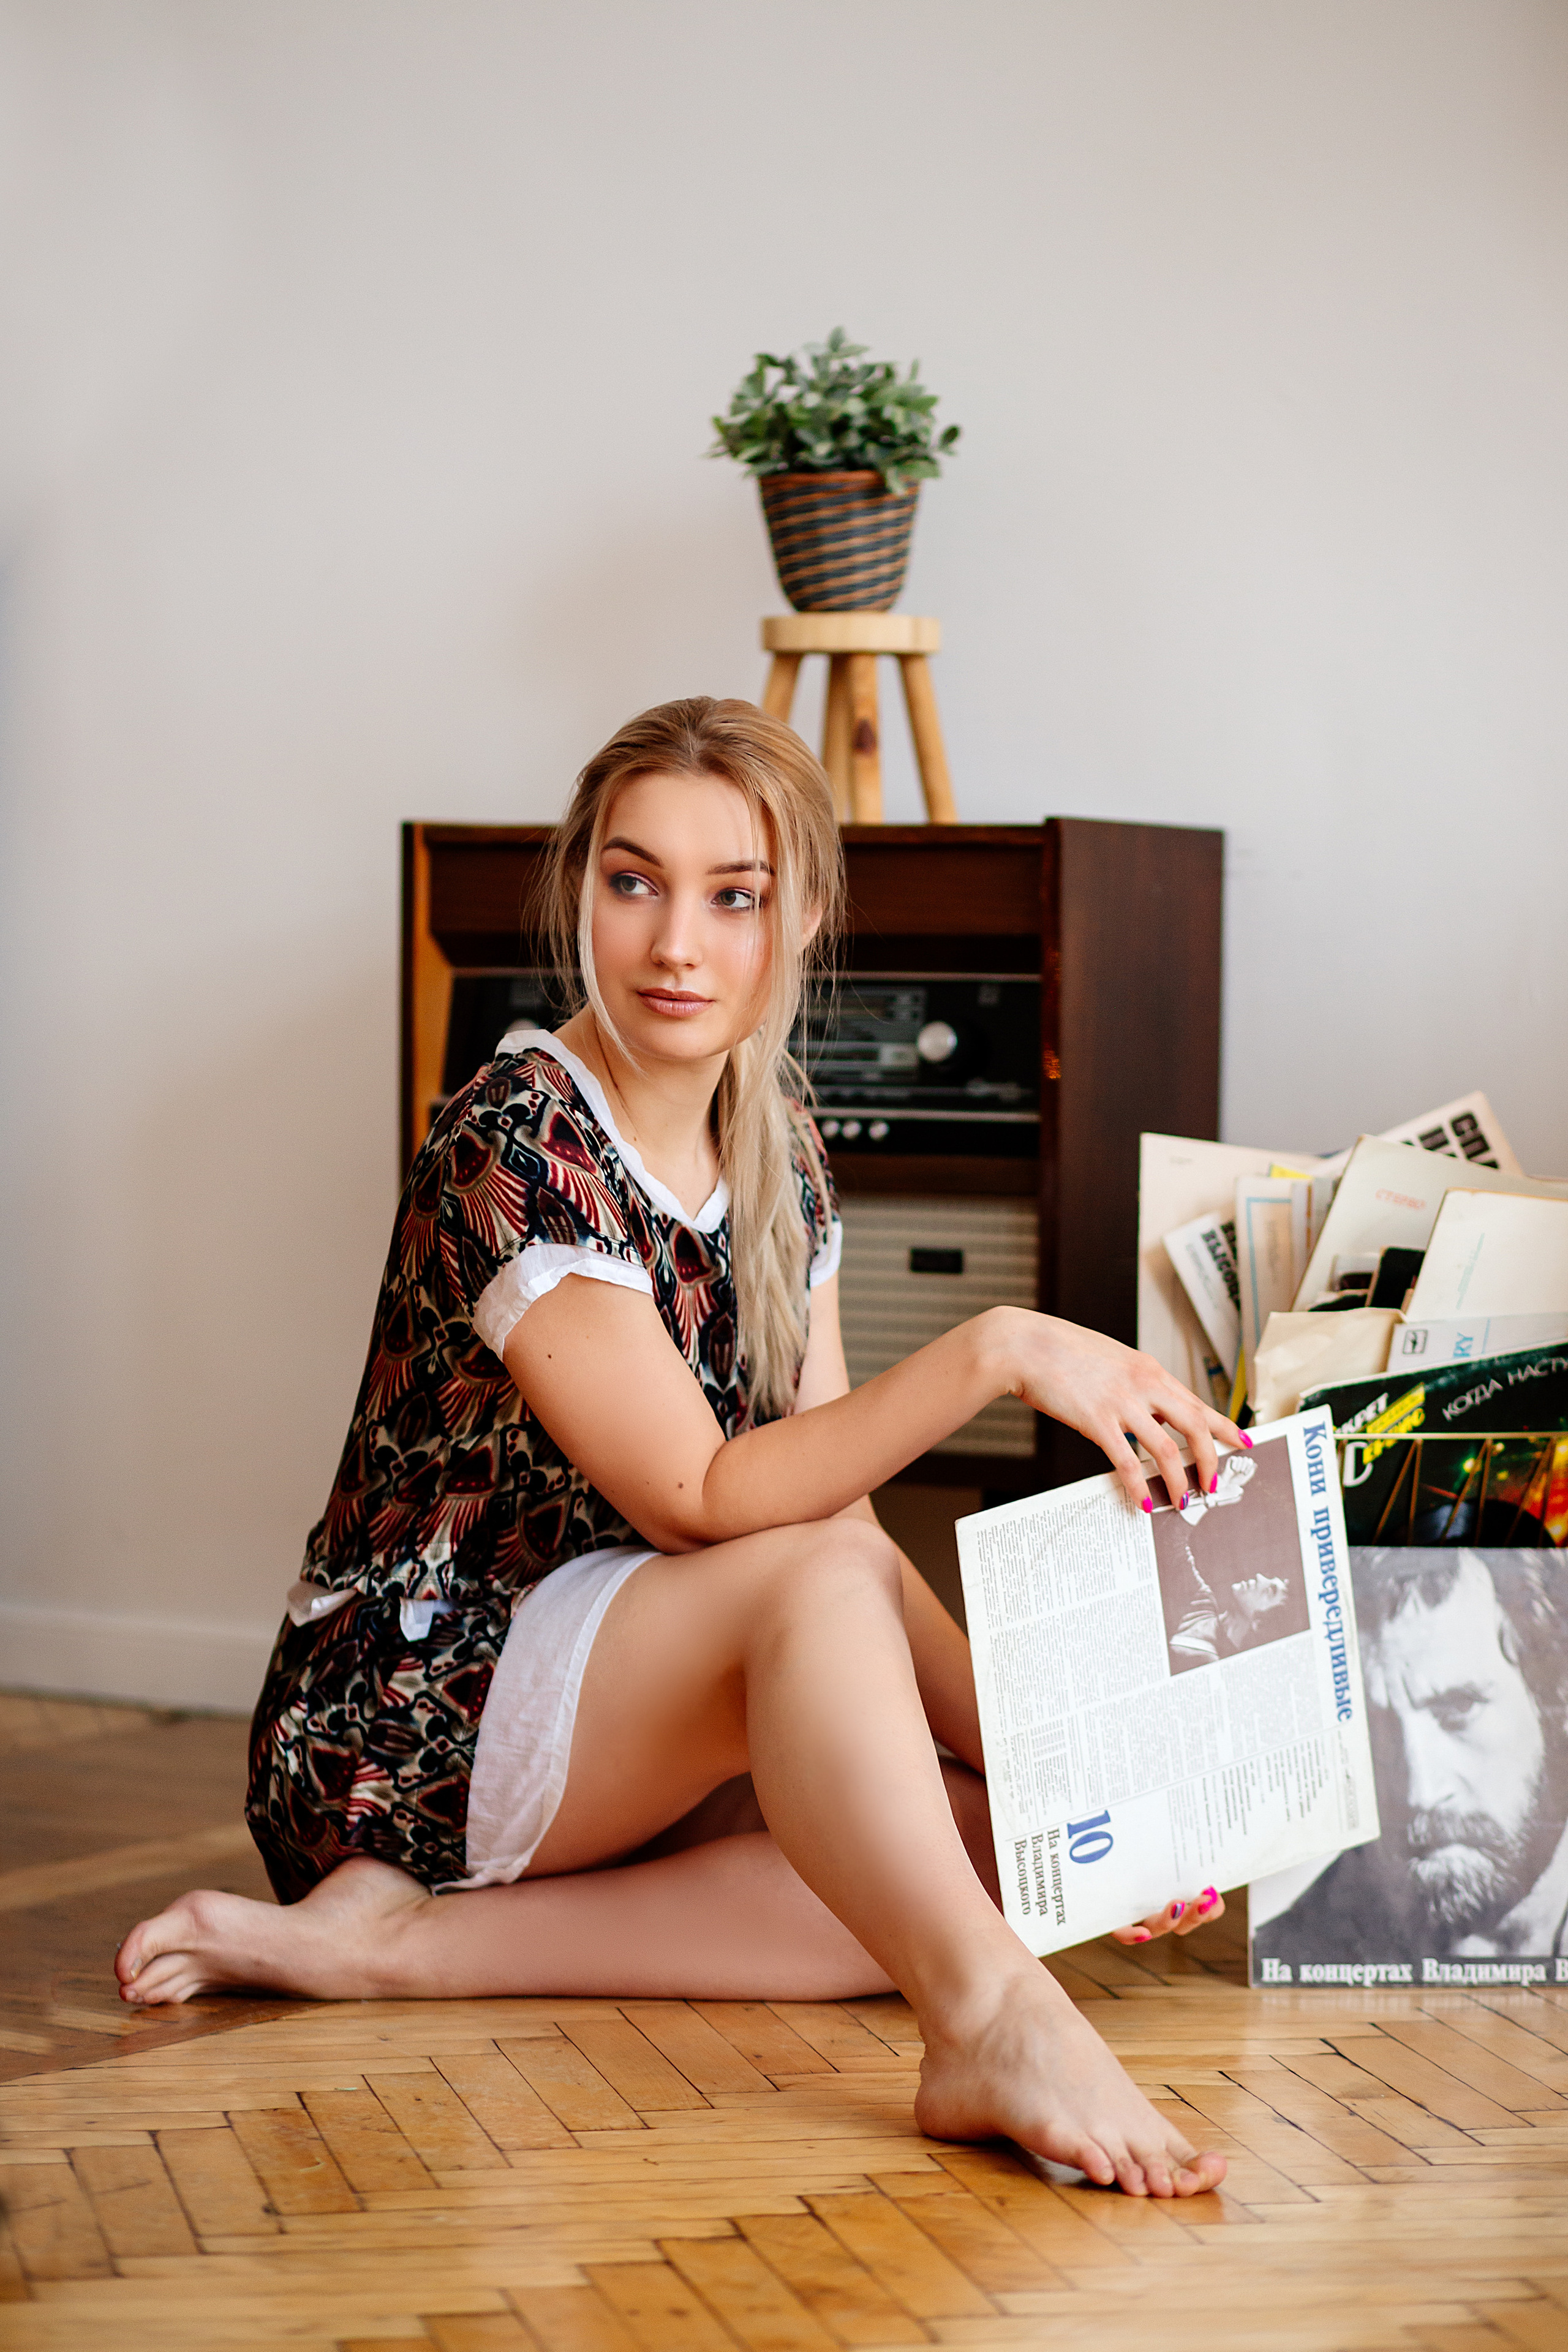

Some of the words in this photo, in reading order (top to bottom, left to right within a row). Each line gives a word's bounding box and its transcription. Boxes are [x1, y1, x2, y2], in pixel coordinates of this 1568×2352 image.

[1201, 1228, 1241, 1312] ВЫСОЦ
[1335, 1392, 1389, 1433] КРЕТ
[1442, 1378, 1504, 1421] КОГДА
[1303, 1420, 1327, 1496] Кони
[1310, 1506, 1352, 1722] привередливые
[1047, 1827, 1060, 1850] На
[1066, 1809, 1114, 1864] 10
[1014, 1838, 1031, 1915] Высоцкого
[1031, 1833, 1048, 1917] Владимира
[1050, 1852, 1066, 1926] концертах
[1261, 1958, 1293, 1983] На
[1299, 1963, 1414, 1988] концертах
[1422, 1957, 1547, 1988] Владимира
